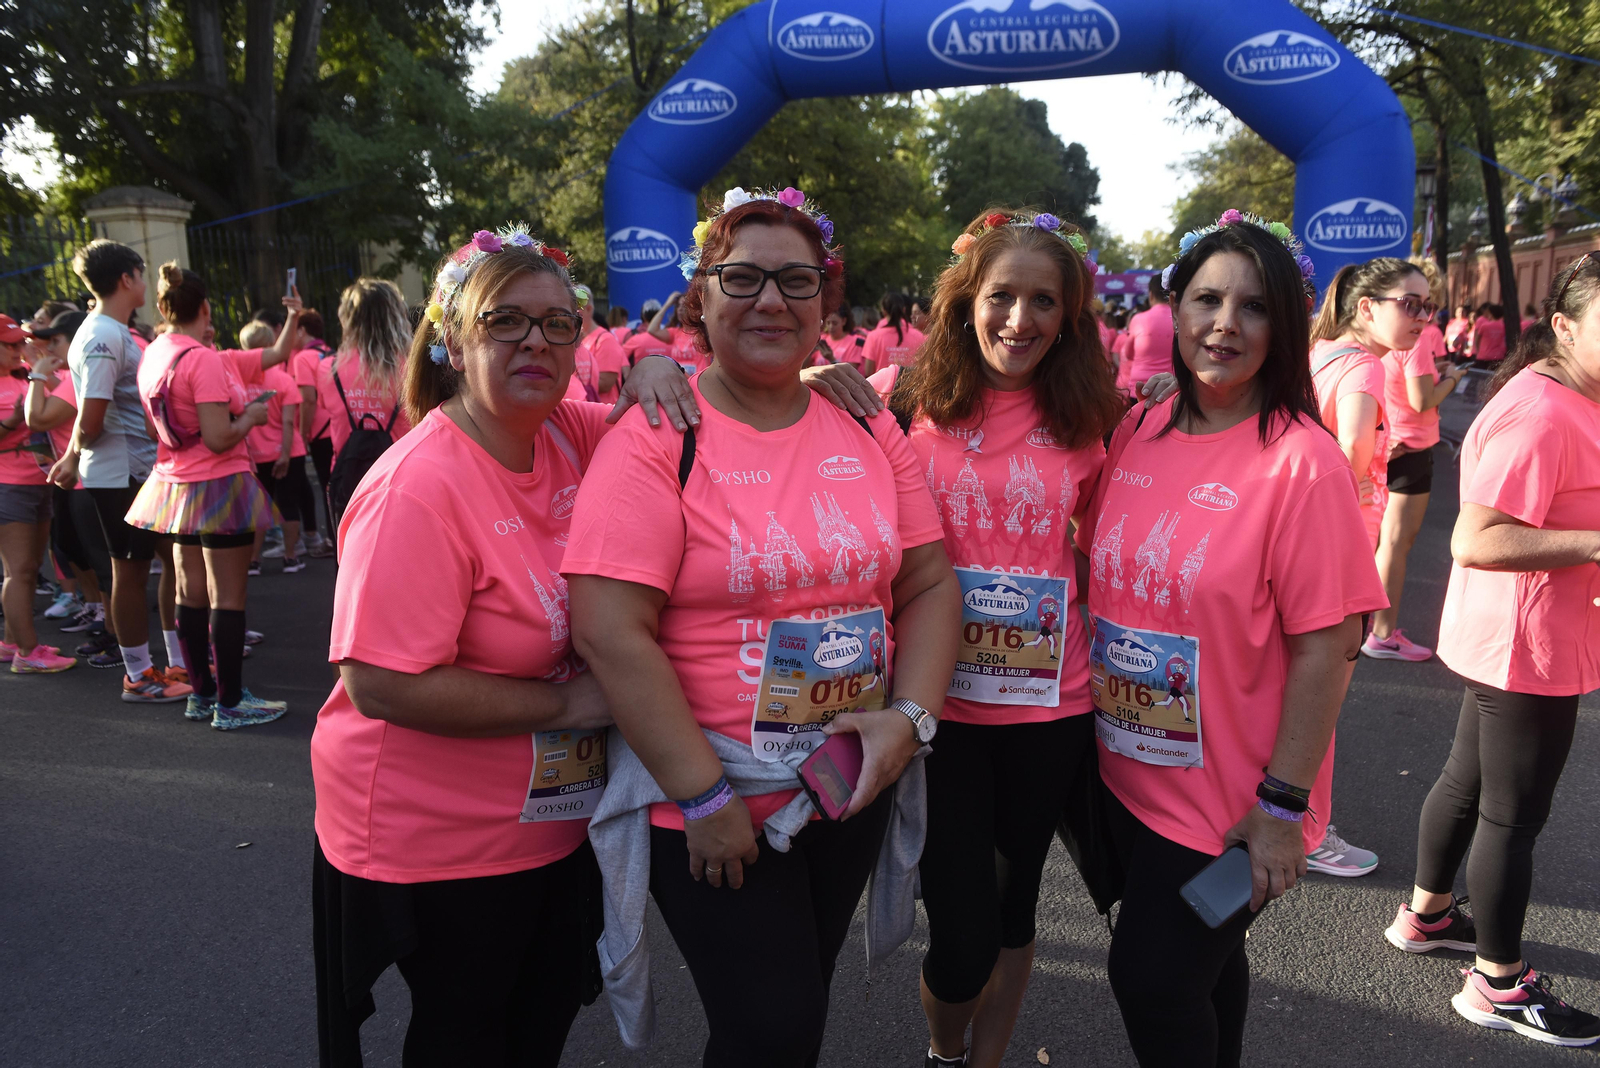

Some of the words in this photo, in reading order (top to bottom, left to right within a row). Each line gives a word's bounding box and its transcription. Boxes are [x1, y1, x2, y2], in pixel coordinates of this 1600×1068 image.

[969, 16, 1030, 28] CENTRAL
[1035, 14, 1098, 26] LECHERA
[785, 29, 867, 49] ASTURIANA
[943, 20, 1104, 55] ASTURIANA
[1233, 52, 1333, 75] ASTURIANA
[652, 99, 730, 116] ASTURIANA
[1311, 219, 1402, 241] ASTURIANA
[349, 400, 365, 409] DE
[368, 400, 382, 409] LA
[709, 468, 771, 485] OYSHO
[1111, 467, 1153, 489] OYSHO
[1191, 489, 1234, 508] ASTURIANA
[968, 592, 1026, 611] ASTURIANA
[963, 621, 1023, 650] 016
[778, 640, 806, 651] SUMA
[976, 651, 1007, 665] 5204
[1109, 645, 1153, 669] ASTURIANA
[982, 666, 994, 675] DE
[994, 667, 1005, 676] LA
[1005, 668, 1030, 677] MUJER
[810, 672, 862, 705] 016
[1108, 674, 1152, 707] 016
[1116, 706, 1140, 722] 5104
[1121, 720, 1130, 730] DE
[1130, 723, 1139, 732] LA
[1141, 726, 1167, 738] MUJER
[763, 740, 812, 752] OYSHO
[1146, 744, 1189, 758] Santander
[560, 780, 593, 795] CARRERA
[593, 777, 602, 787] DE
[536, 799, 584, 815] OYSHO
